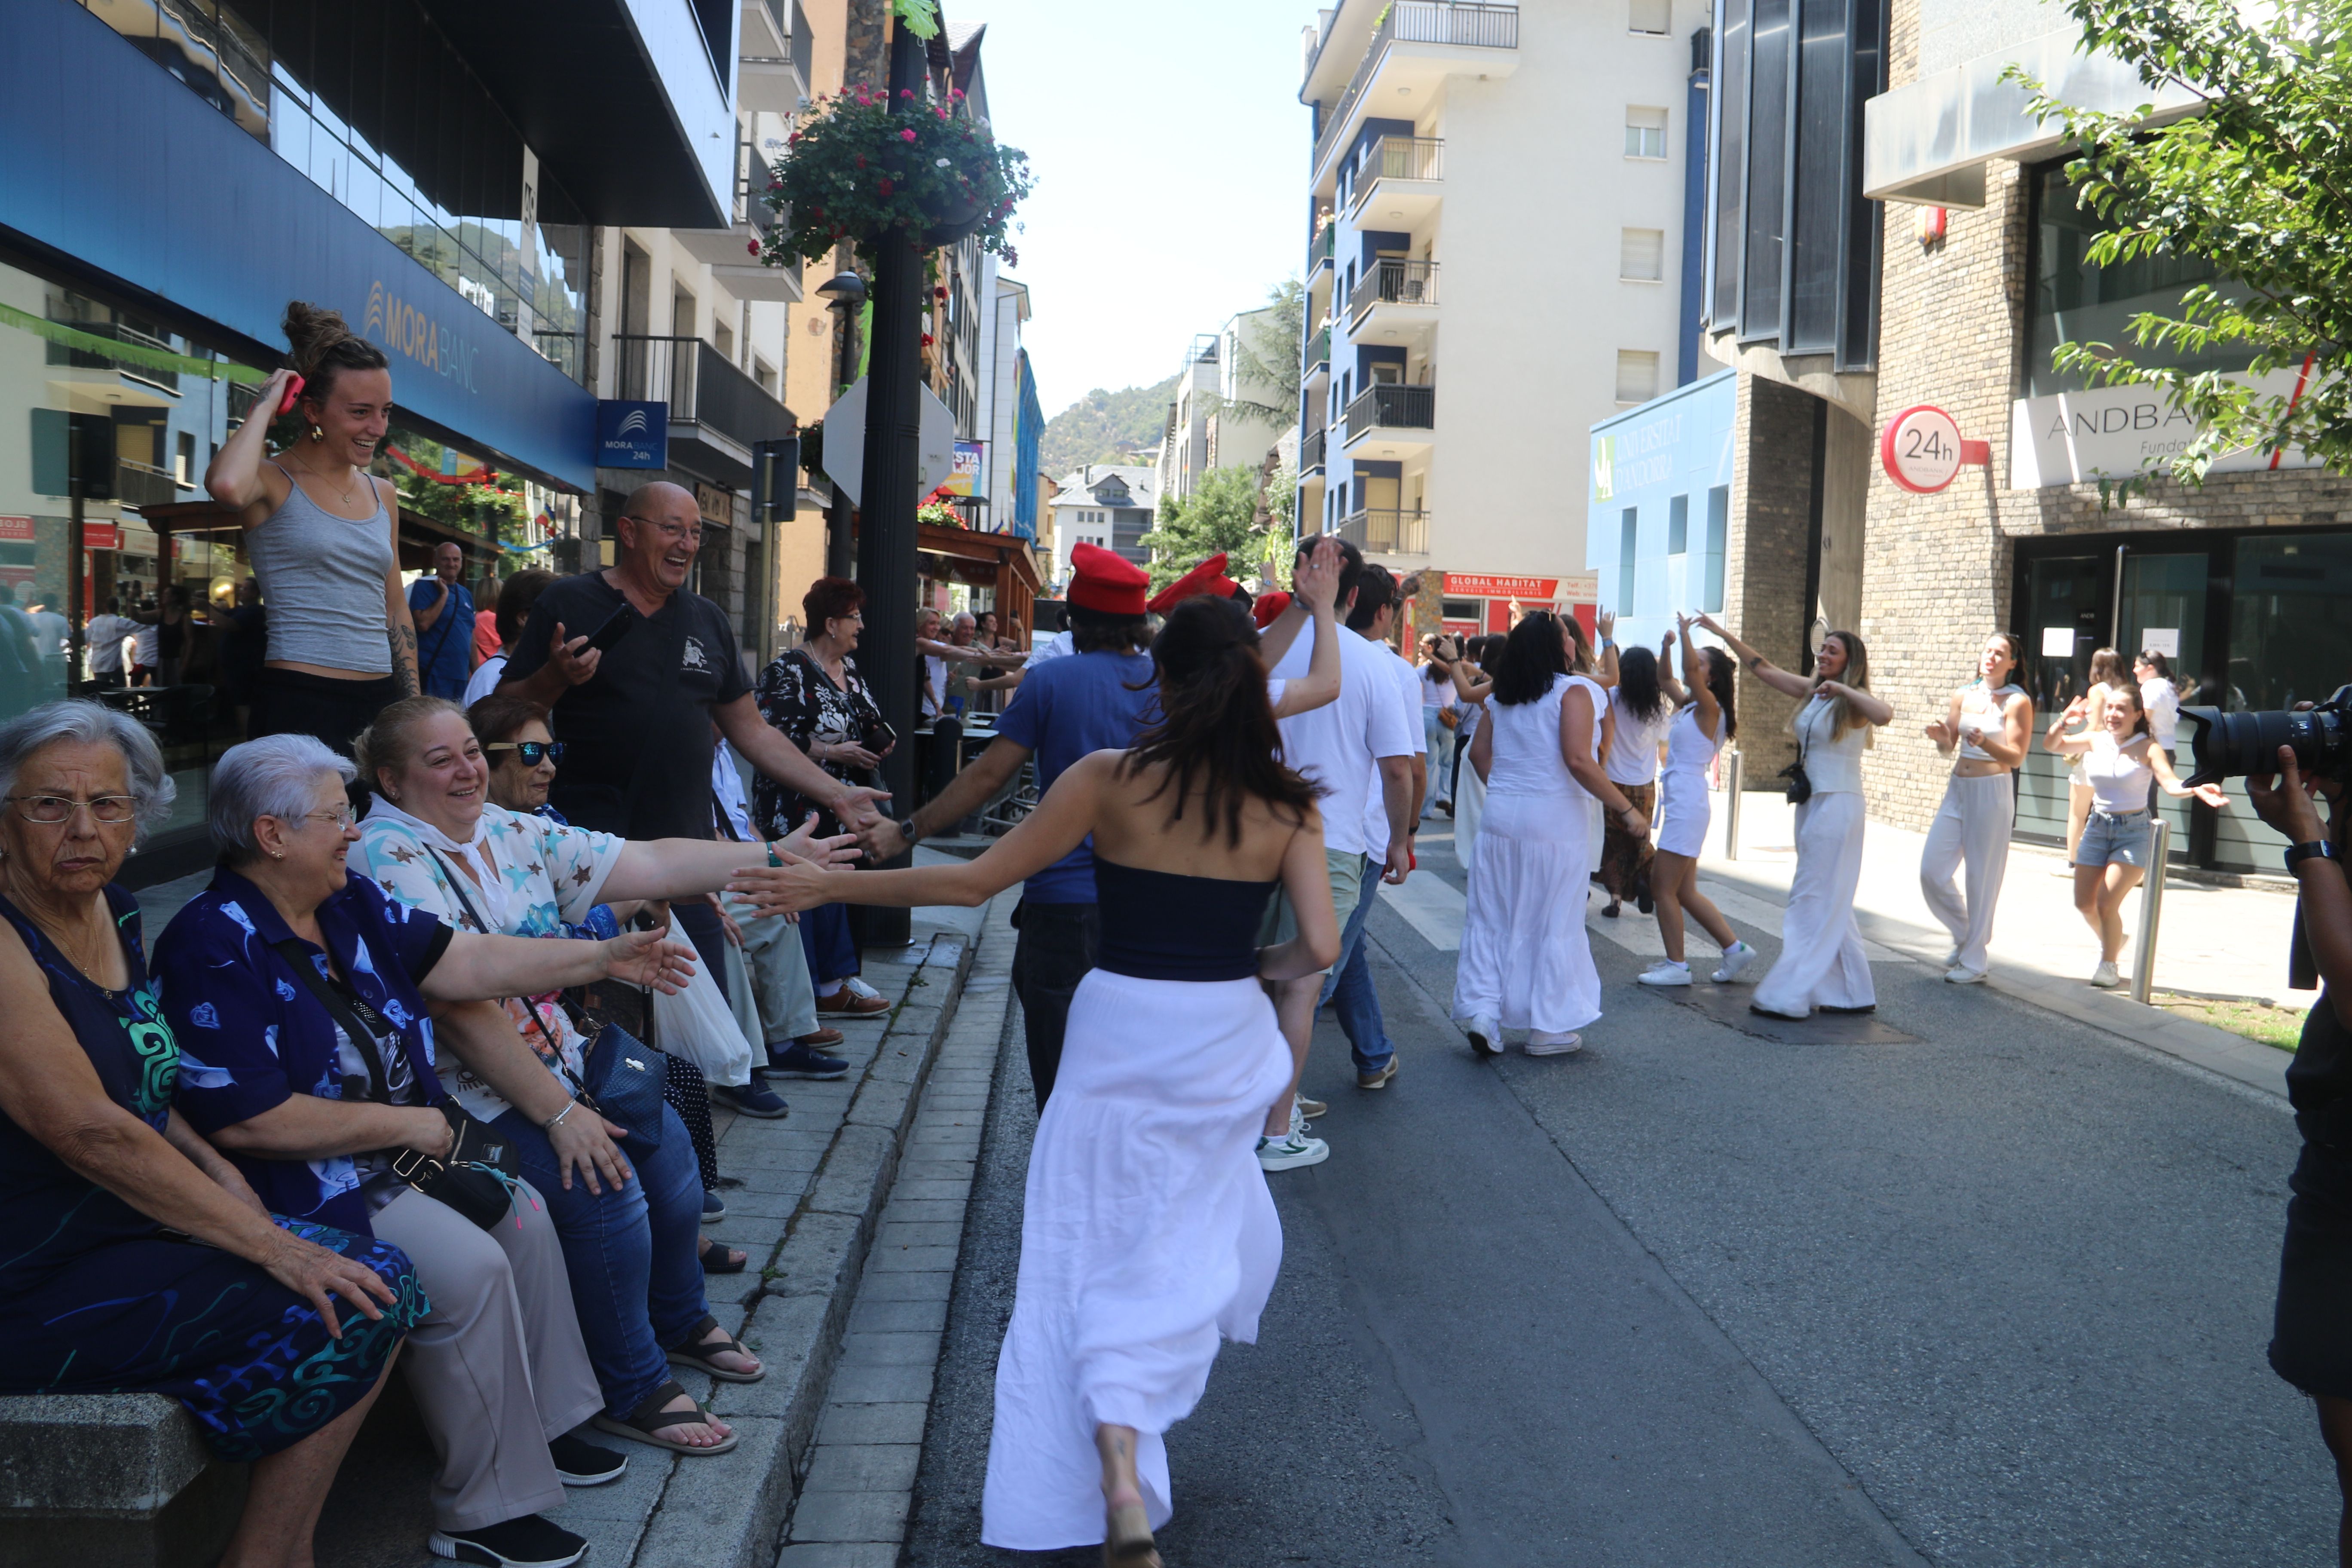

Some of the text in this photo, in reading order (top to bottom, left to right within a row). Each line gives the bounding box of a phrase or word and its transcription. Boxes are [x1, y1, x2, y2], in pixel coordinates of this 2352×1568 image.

[2048, 403, 2205, 439] ANDBA
[1616, 415, 1683, 462] UNIVERSITAT
[1905, 428, 1953, 461] 24h
[633, 451, 650, 460] 24h
[1908, 466, 1943, 474] ANDBANK
[1451, 576, 1542, 588] GLOBAL HABITAT
